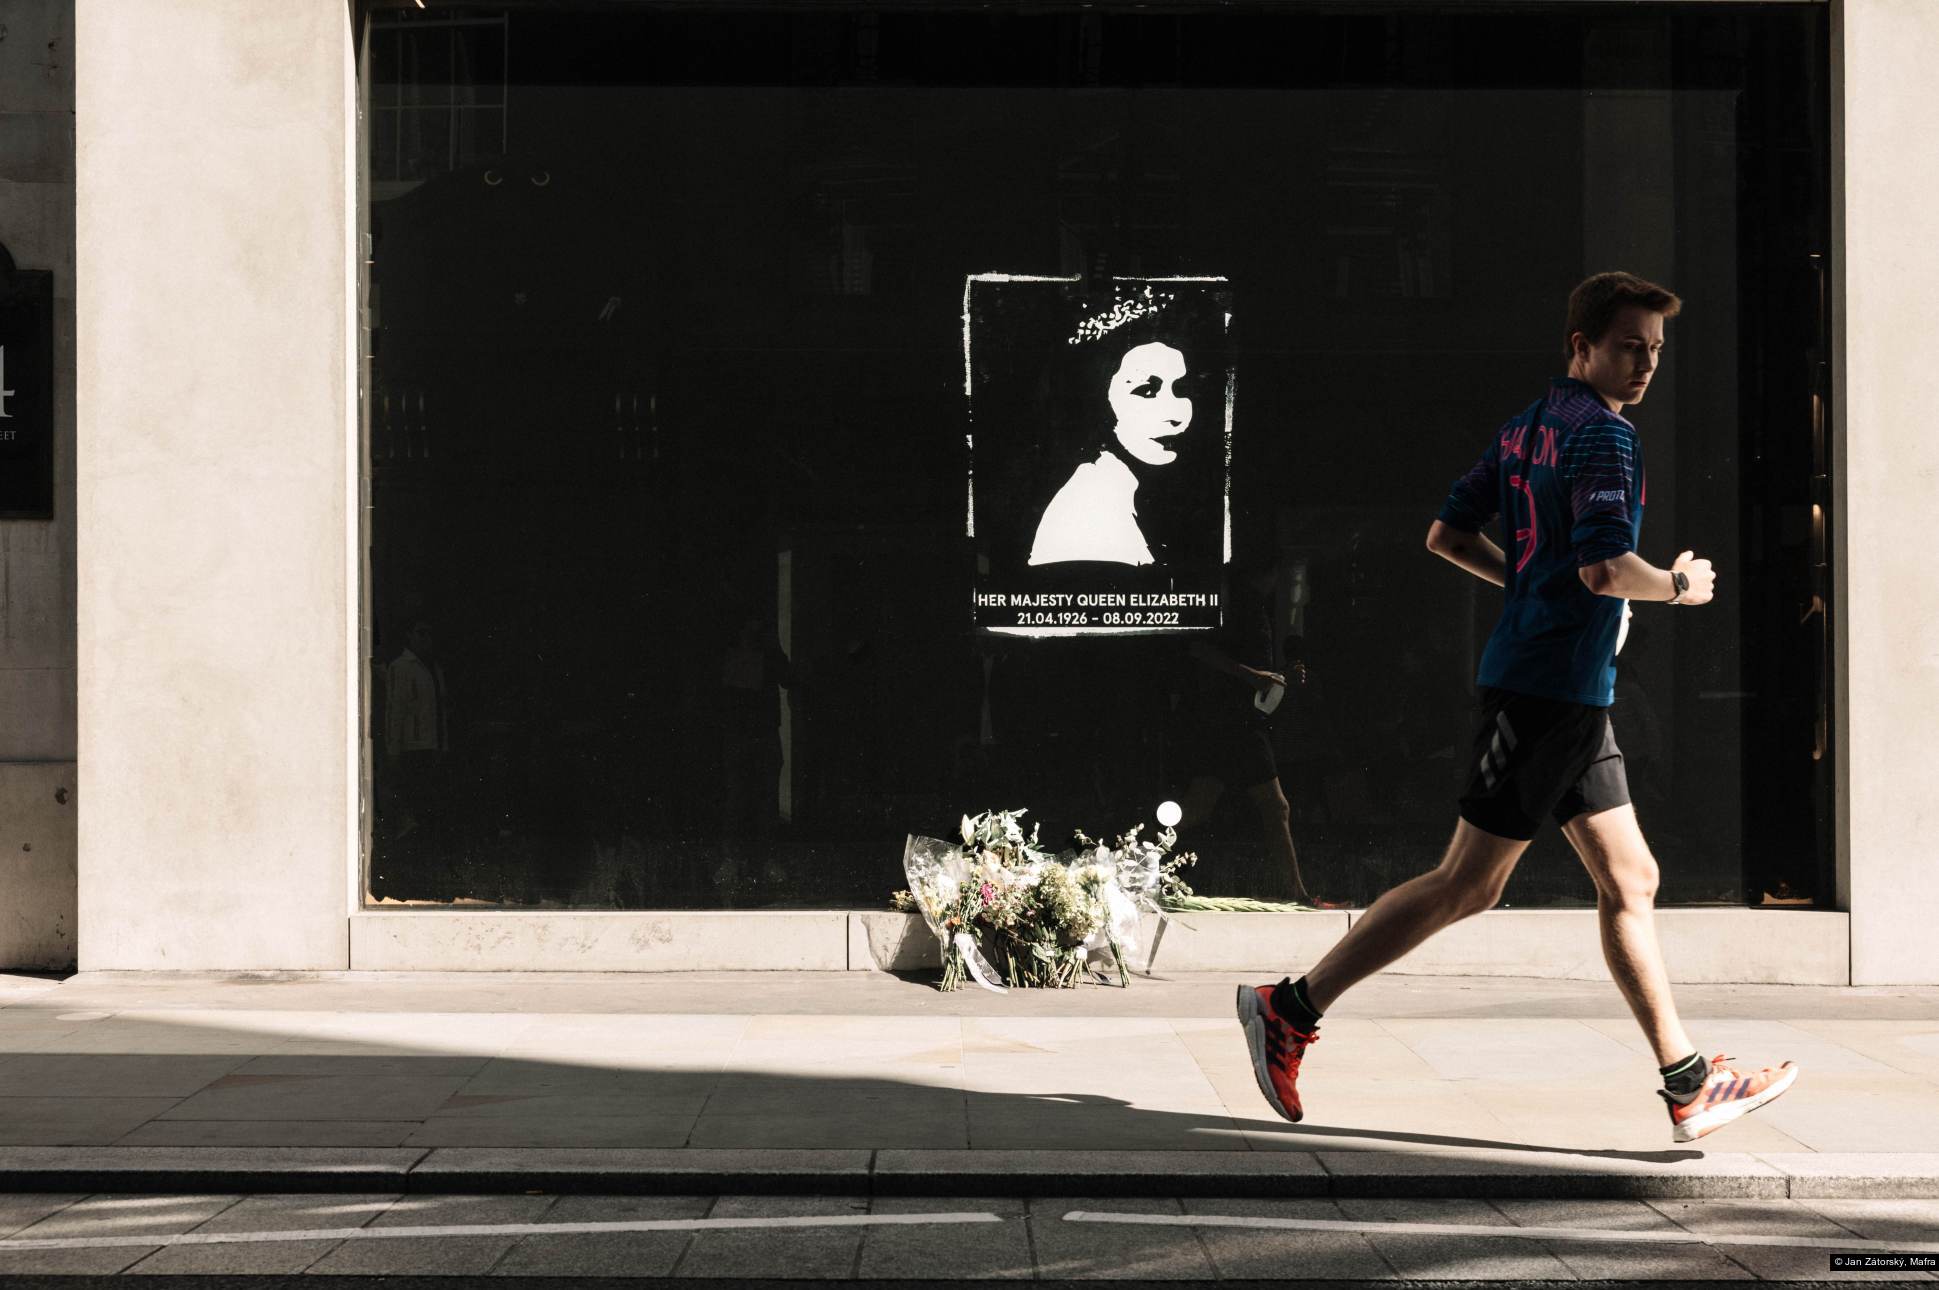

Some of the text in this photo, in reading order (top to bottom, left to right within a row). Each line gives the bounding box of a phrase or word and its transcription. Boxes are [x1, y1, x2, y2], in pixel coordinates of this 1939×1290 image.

[978, 594, 1219, 607] HER MAJESTY QUEEN ELIZABETH II
[1017, 612, 1088, 625] 21.04.1926
[1103, 612, 1179, 625] 08.09.2022
